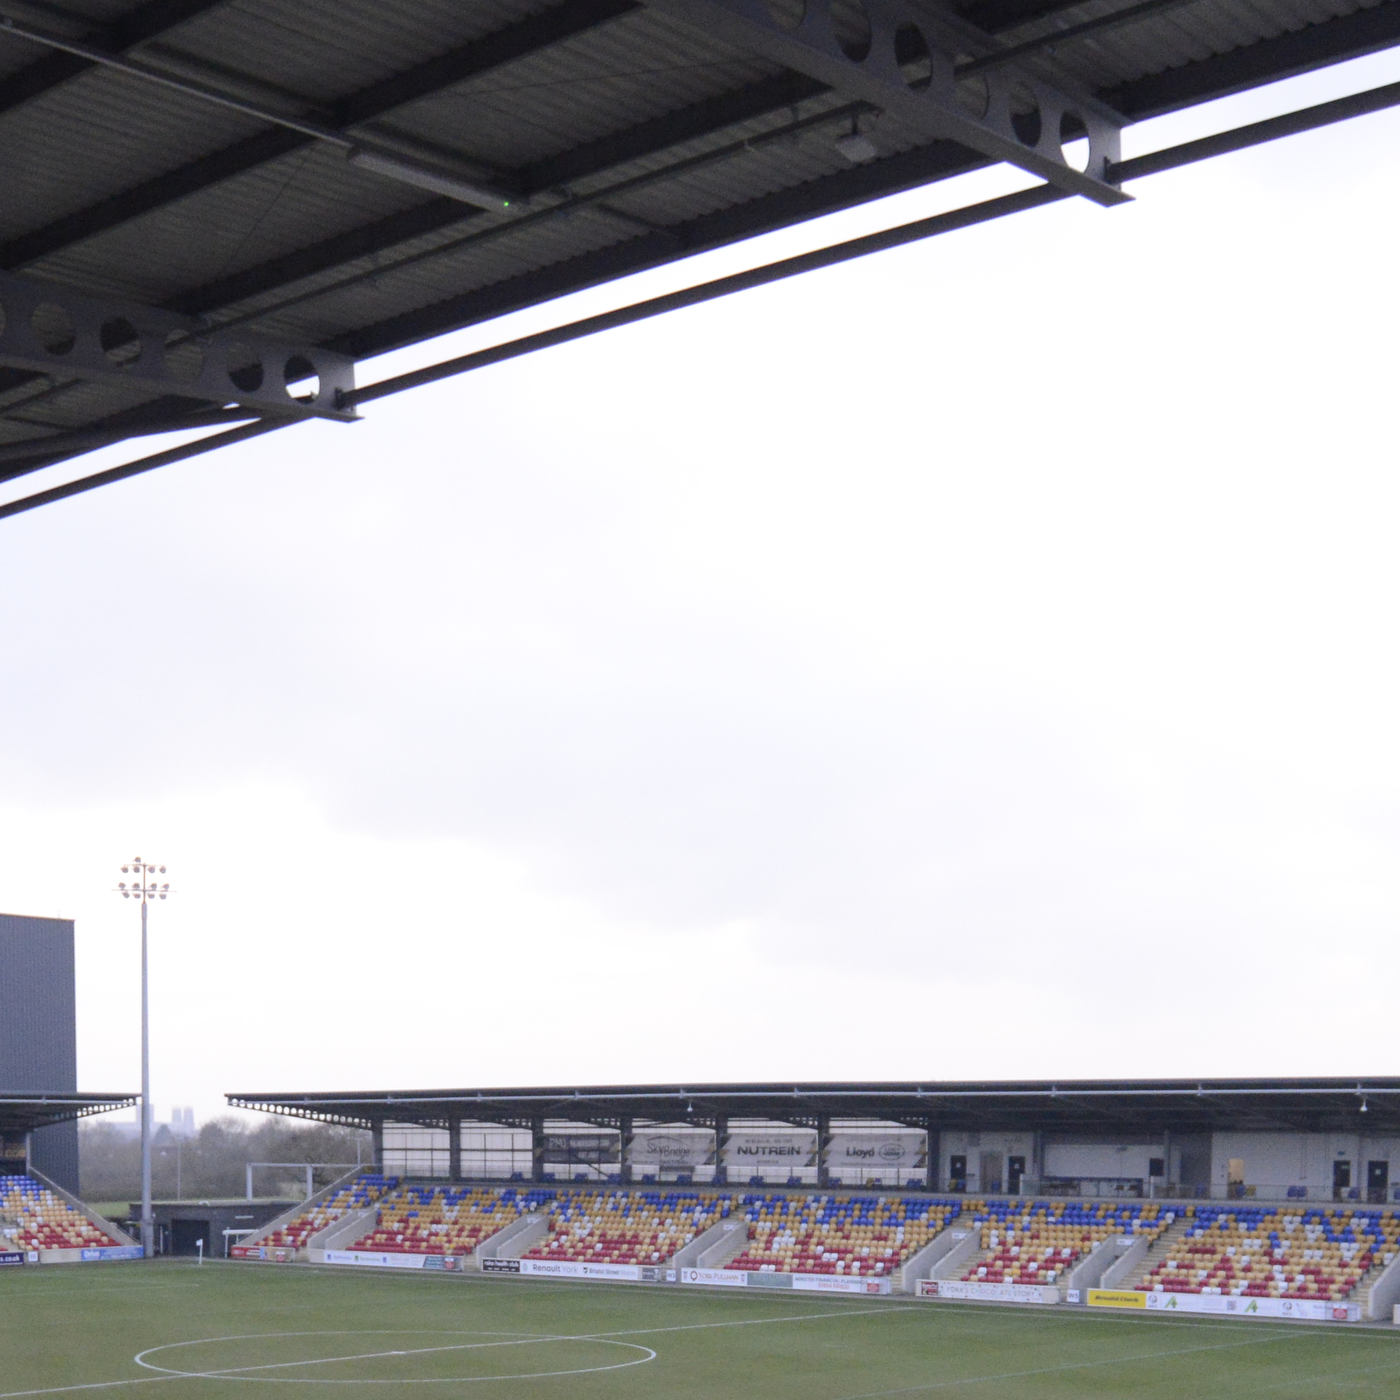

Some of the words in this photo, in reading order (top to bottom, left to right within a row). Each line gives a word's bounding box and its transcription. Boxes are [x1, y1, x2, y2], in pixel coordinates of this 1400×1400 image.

[737, 1146, 801, 1156] NUTREIN
[846, 1147, 875, 1159] Lloyd
[533, 1264, 561, 1272] Renault
